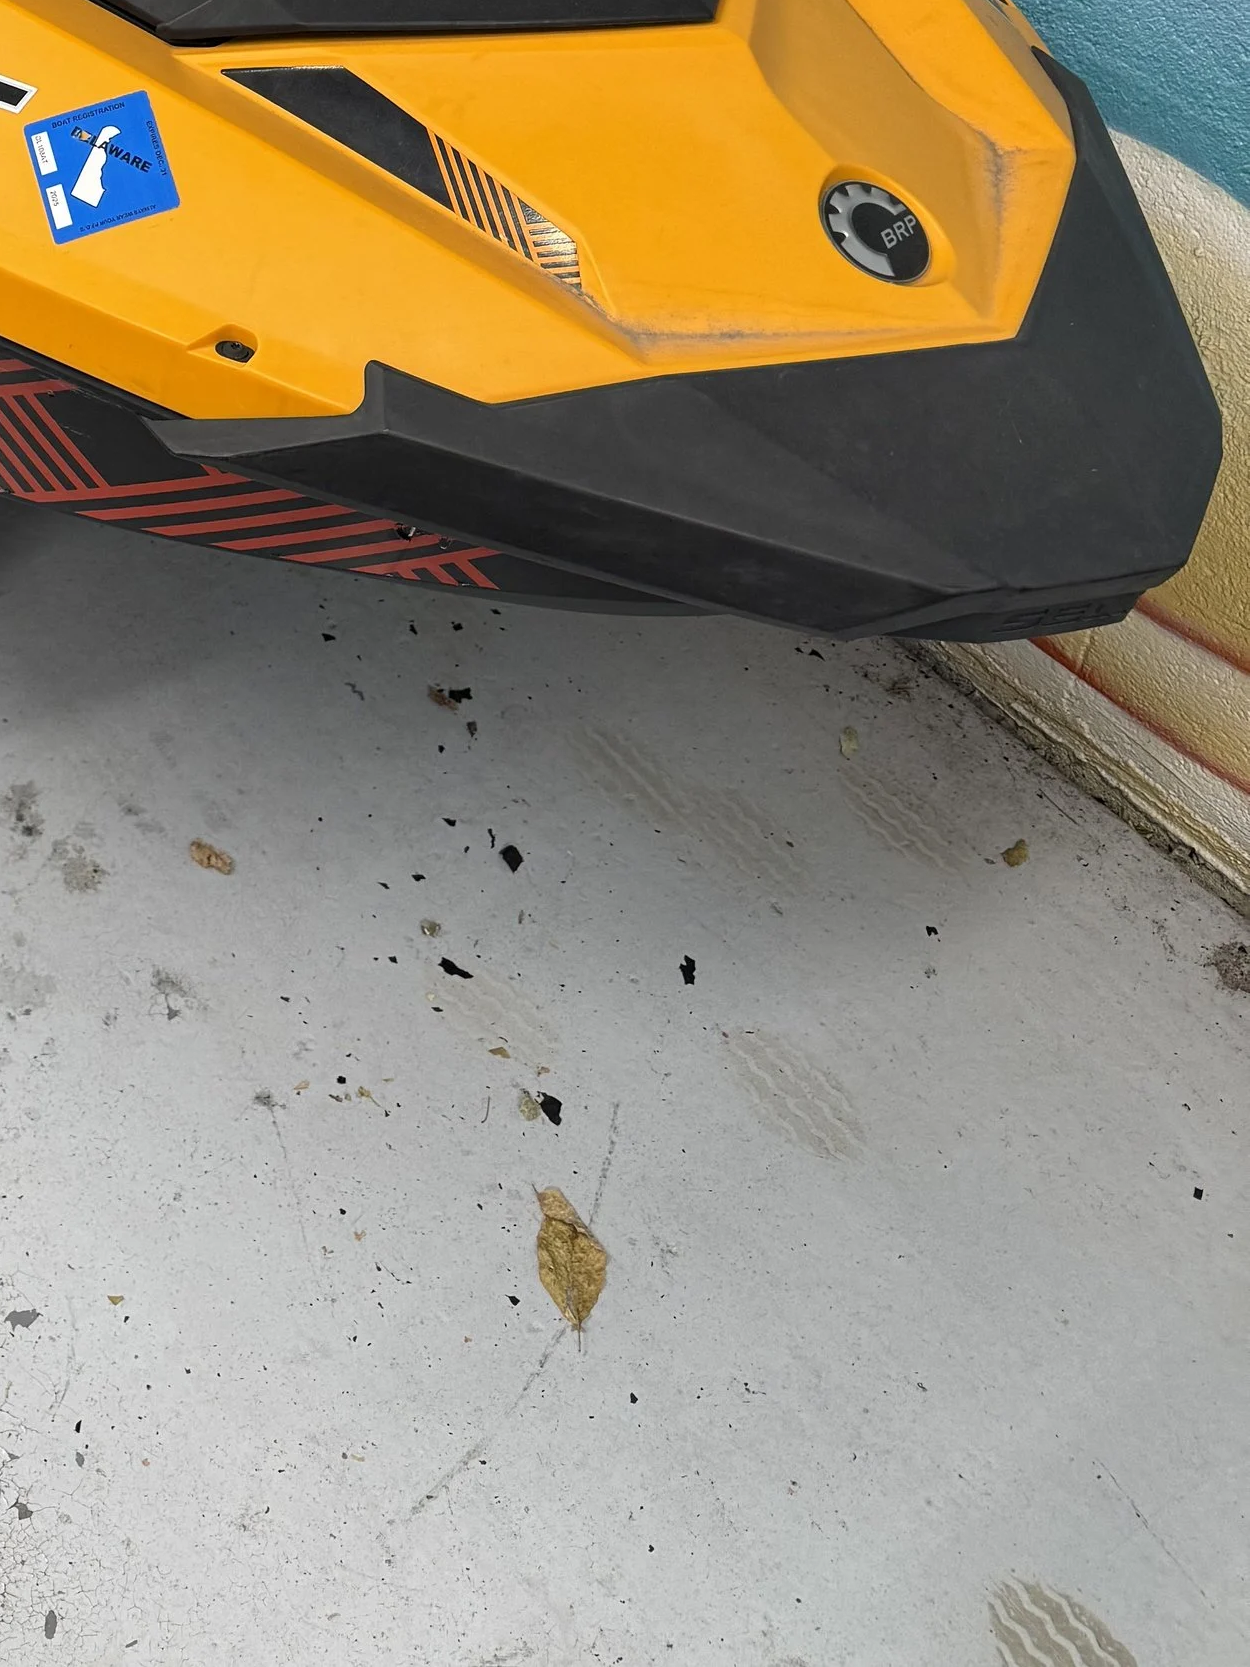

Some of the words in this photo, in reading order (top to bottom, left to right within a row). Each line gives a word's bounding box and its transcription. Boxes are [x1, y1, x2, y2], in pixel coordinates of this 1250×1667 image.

[51, 117, 72, 129] BOAT
[72, 101, 126, 122] REGISTRATION
[880, 215, 917, 249] BRP
